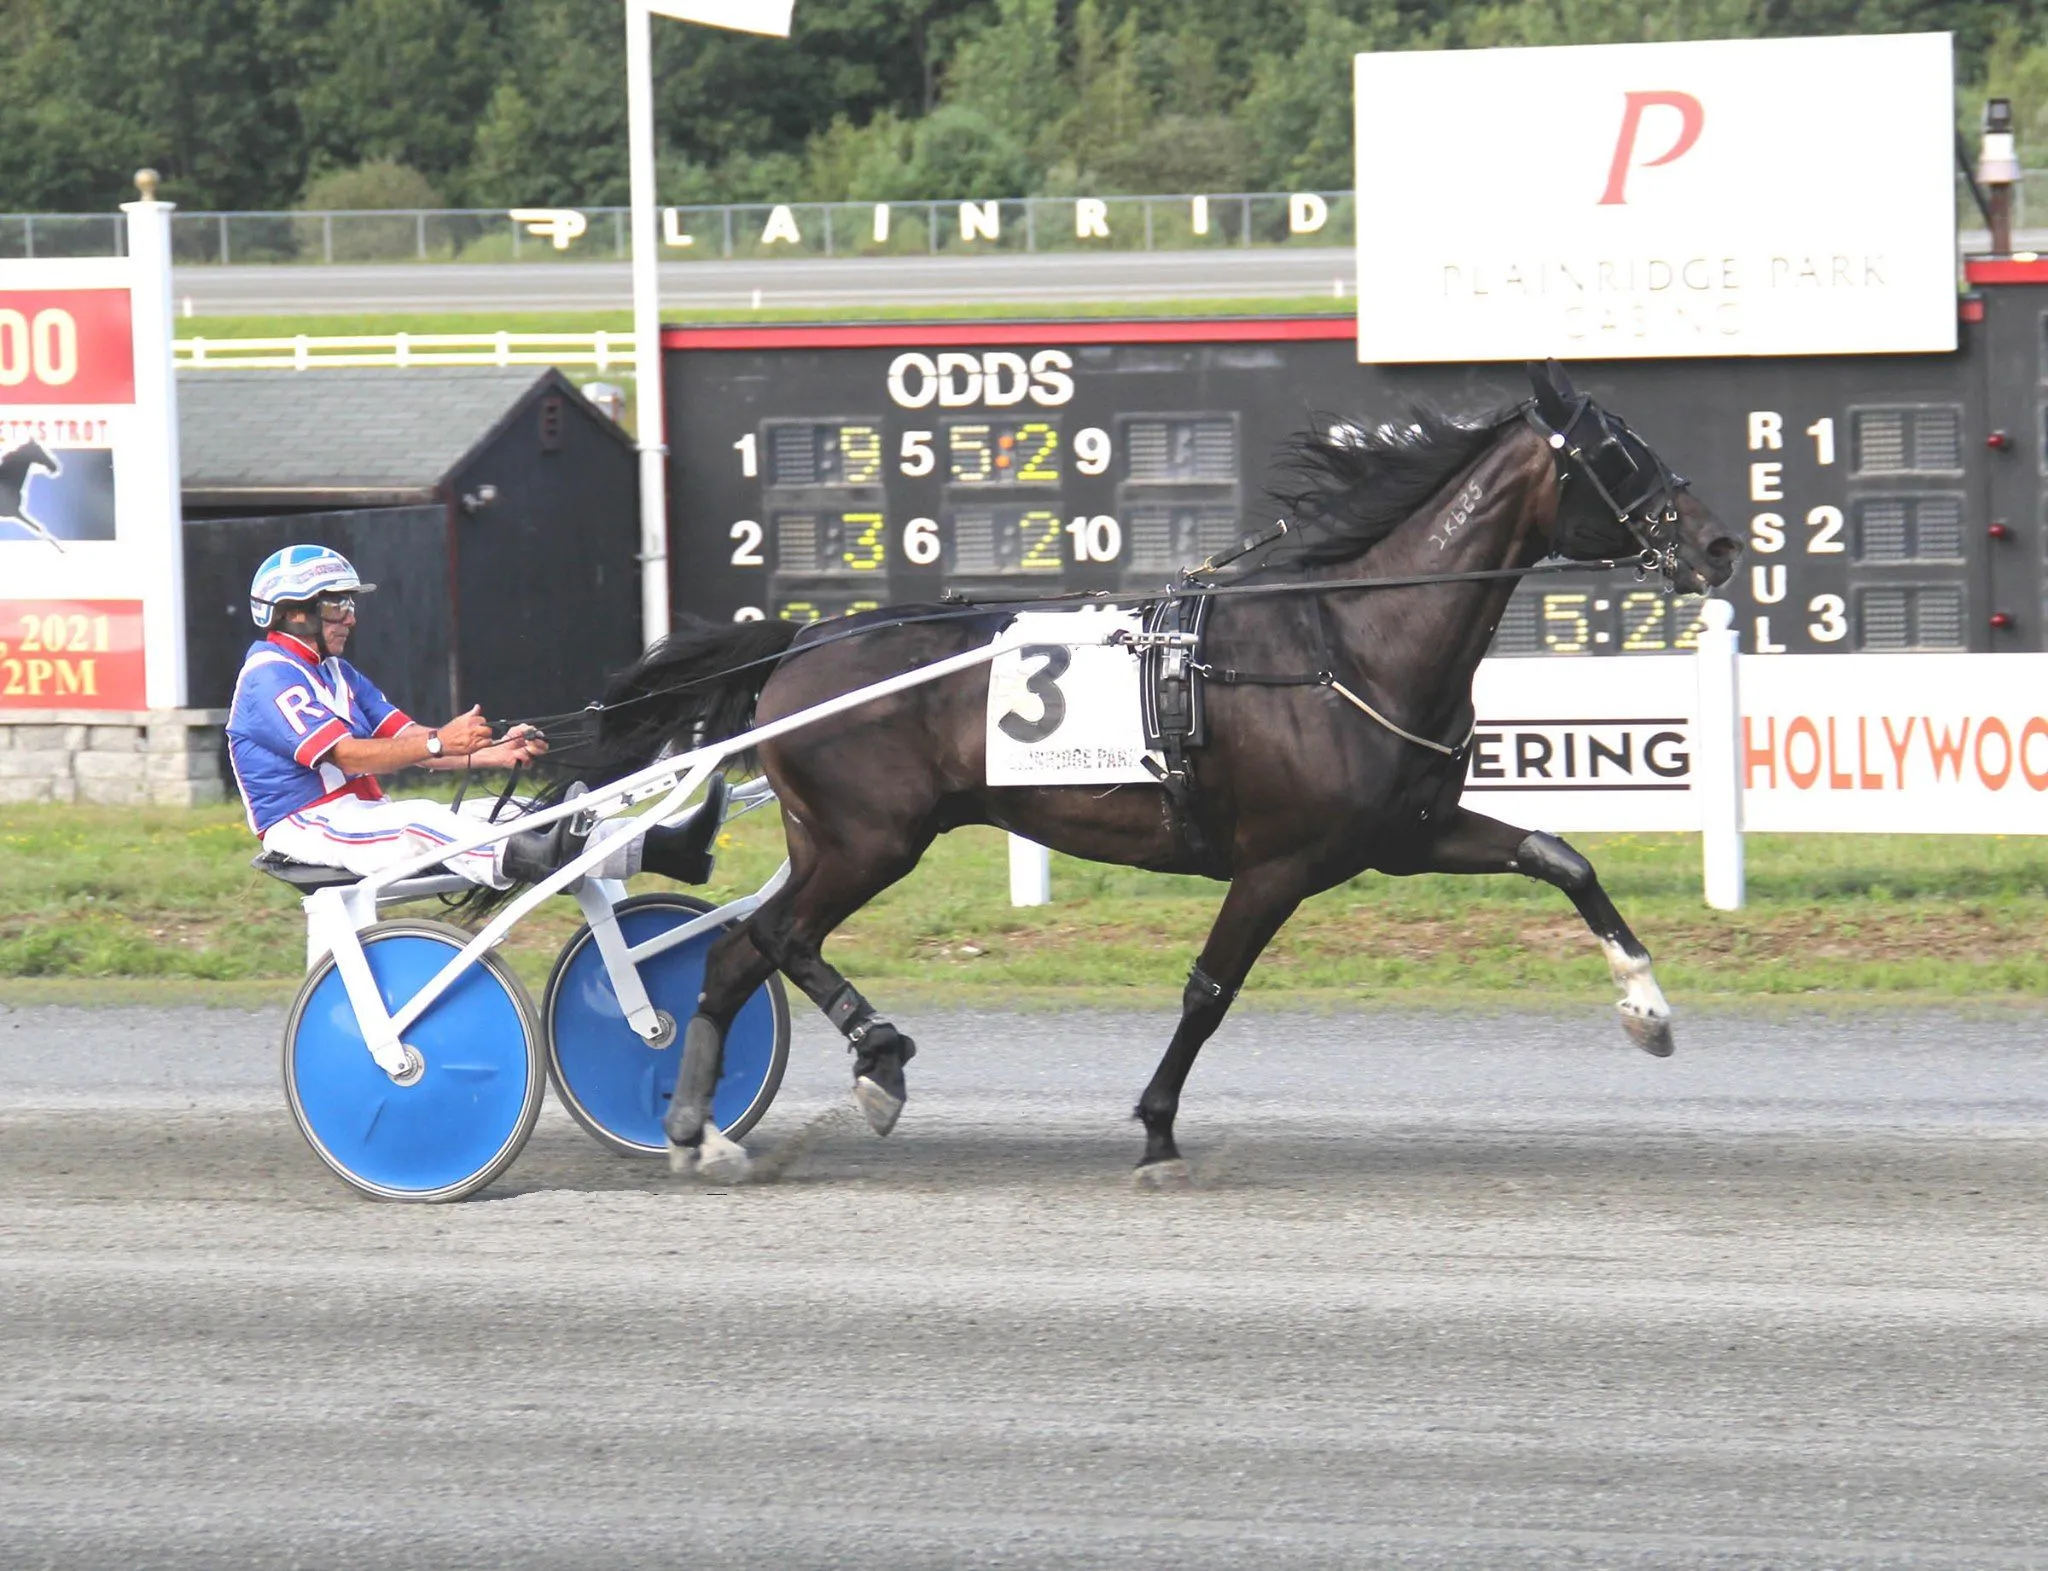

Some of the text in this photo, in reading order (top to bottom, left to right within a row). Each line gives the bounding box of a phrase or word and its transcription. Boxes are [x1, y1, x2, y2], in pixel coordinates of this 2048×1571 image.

[1597, 90, 1706, 205] P
[1769, 253, 1888, 289] PARK
[1563, 300, 1745, 341] CASNO
[888, 350, 1074, 408] ODDS
[54, 419, 107, 442] TROT
[900, 431, 935, 476] 5
[949, 423, 1060, 481] 5:2
[1074, 428, 1111, 474] 9
[1807, 418, 1834, 464] 1
[734, 434, 757, 476] 1
[840, 426, 881, 482] 9
[731, 520, 763, 564] 2
[842, 513, 884, 570] 3
[904, 518, 940, 564] 6
[1019, 511, 1062, 567] 2
[1066, 515, 1121, 561] 10
[1807, 506, 1844, 552] 2
[19, 614, 109, 652] 2021
[1809, 594, 1847, 641] 3
[2, 658, 99, 695] 2PM
[998, 644, 1072, 743] 3
[275, 684, 326, 736] R
[1472, 732, 1691, 778] ERING
[1741, 715, 2048, 791] HOLLYWOO
